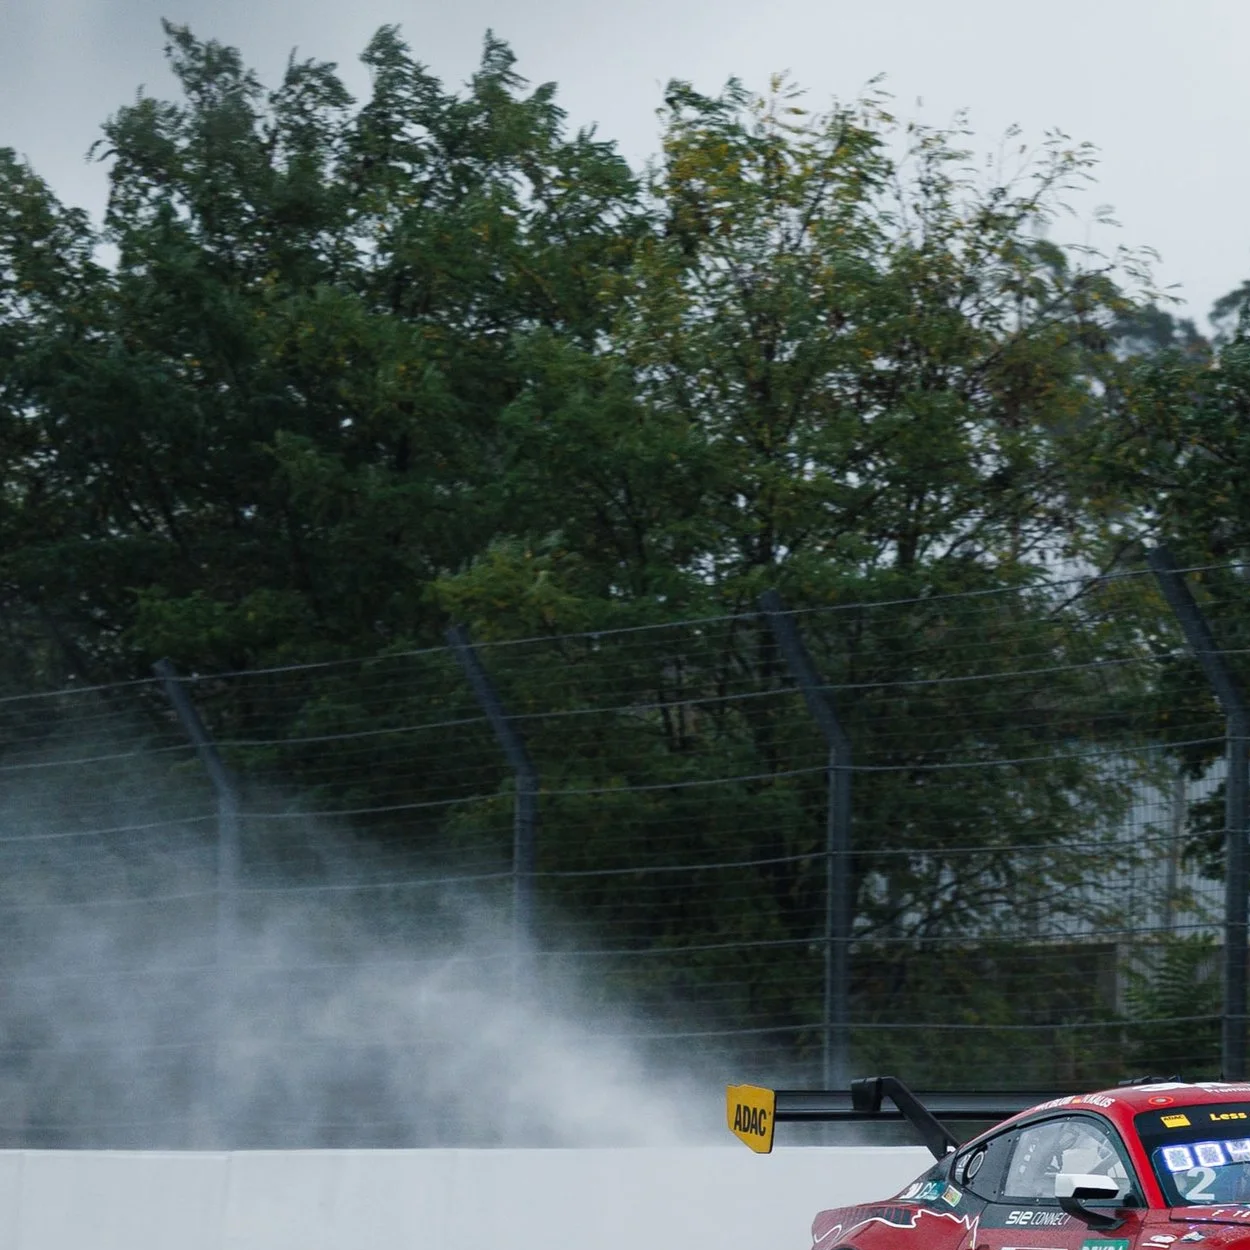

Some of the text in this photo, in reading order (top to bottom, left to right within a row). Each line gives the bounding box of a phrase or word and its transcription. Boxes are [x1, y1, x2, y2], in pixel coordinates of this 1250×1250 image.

[734, 1104, 767, 1136] ADAC
[1210, 1112, 1248, 1121] Less
[1185, 1166, 1217, 1200] 2
[1030, 1211, 1071, 1226] CONNECT
